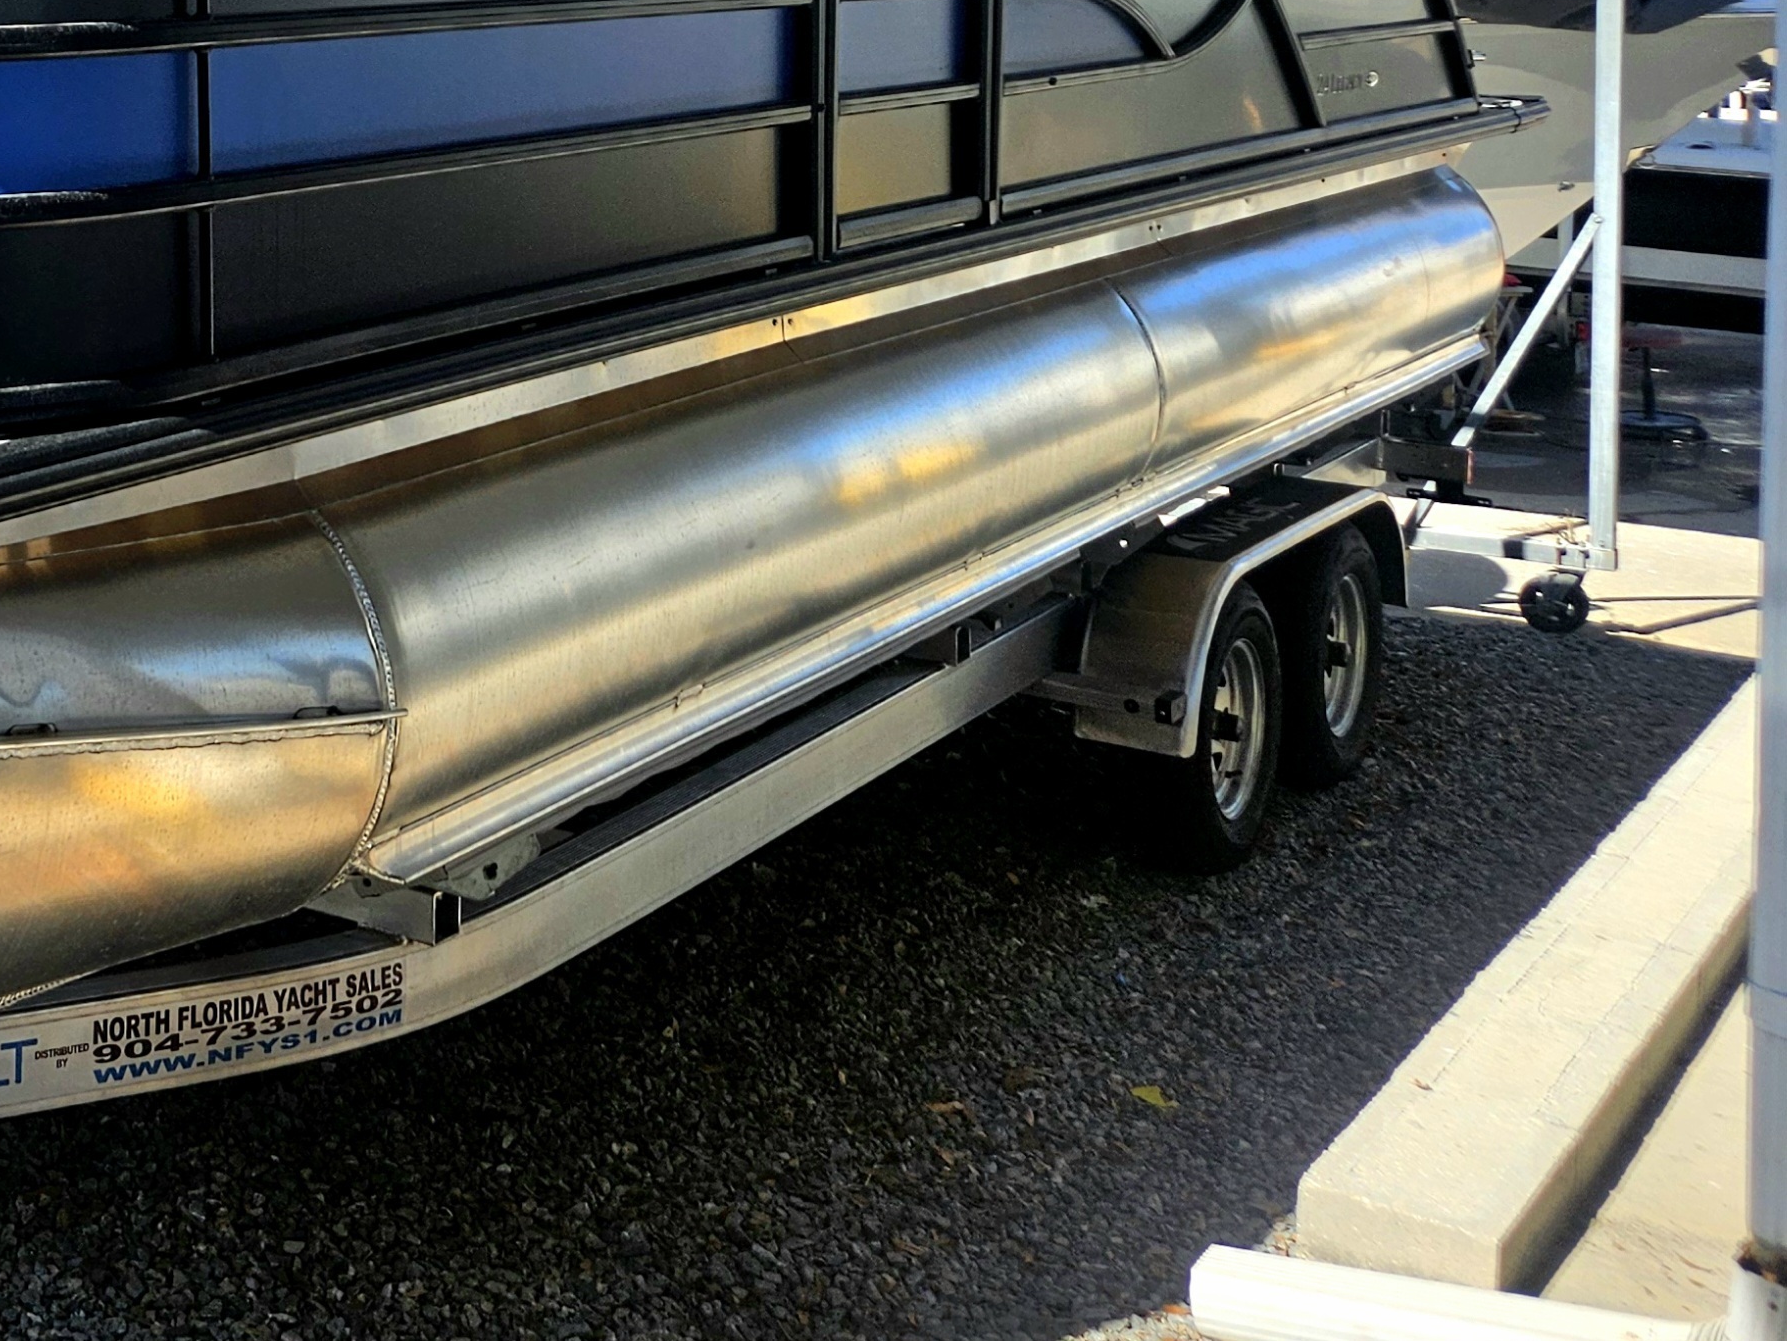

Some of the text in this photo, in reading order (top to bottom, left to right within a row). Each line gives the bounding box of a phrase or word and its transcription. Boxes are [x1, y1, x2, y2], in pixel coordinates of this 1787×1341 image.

[93, 962, 404, 1045] NORTH FLORIDA YACHT SALES
[93, 988, 404, 1063] 904-733-7502
[34, 1043, 90, 1060] DISTRIBUTED
[56, 1057, 69, 1069] BY
